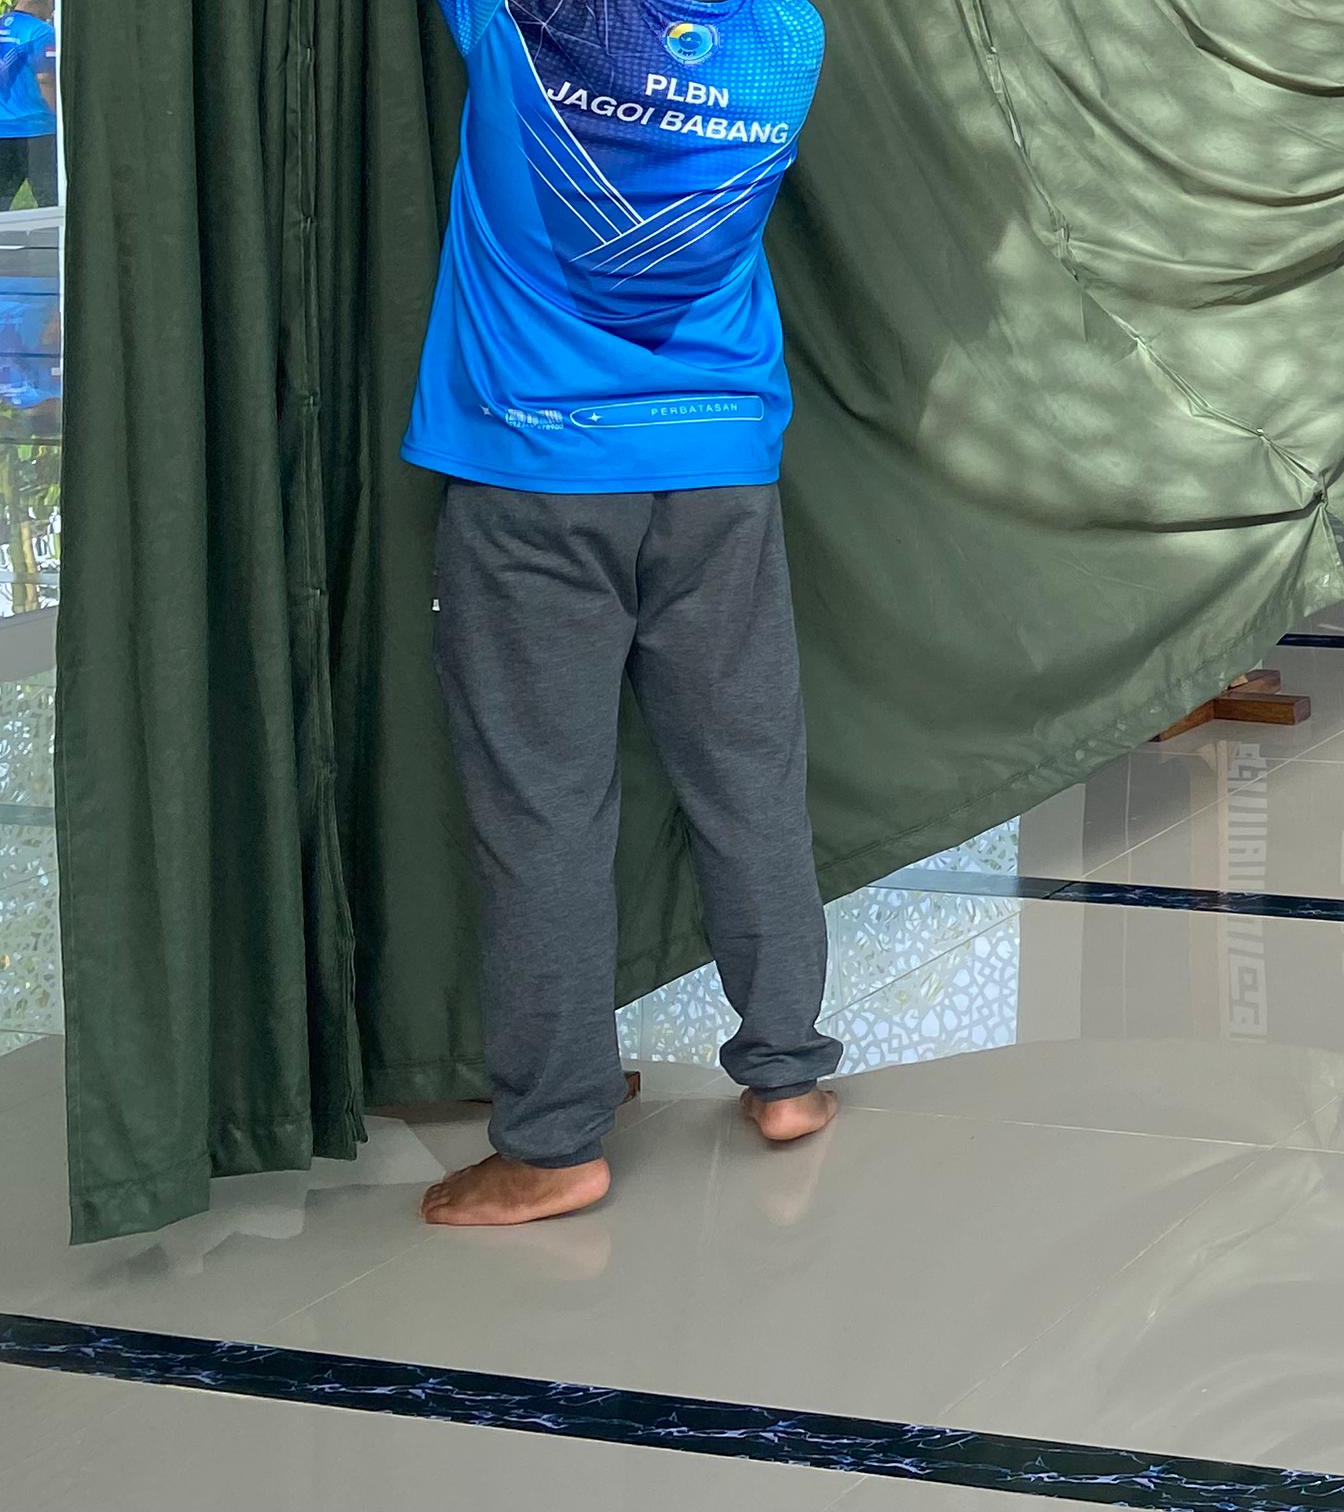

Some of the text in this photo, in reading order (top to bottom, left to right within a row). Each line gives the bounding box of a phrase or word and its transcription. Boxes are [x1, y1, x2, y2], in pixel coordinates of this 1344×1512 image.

[547, 80, 790, 145] JAGOI BABANG
[645, 73, 730, 109] PLBN
